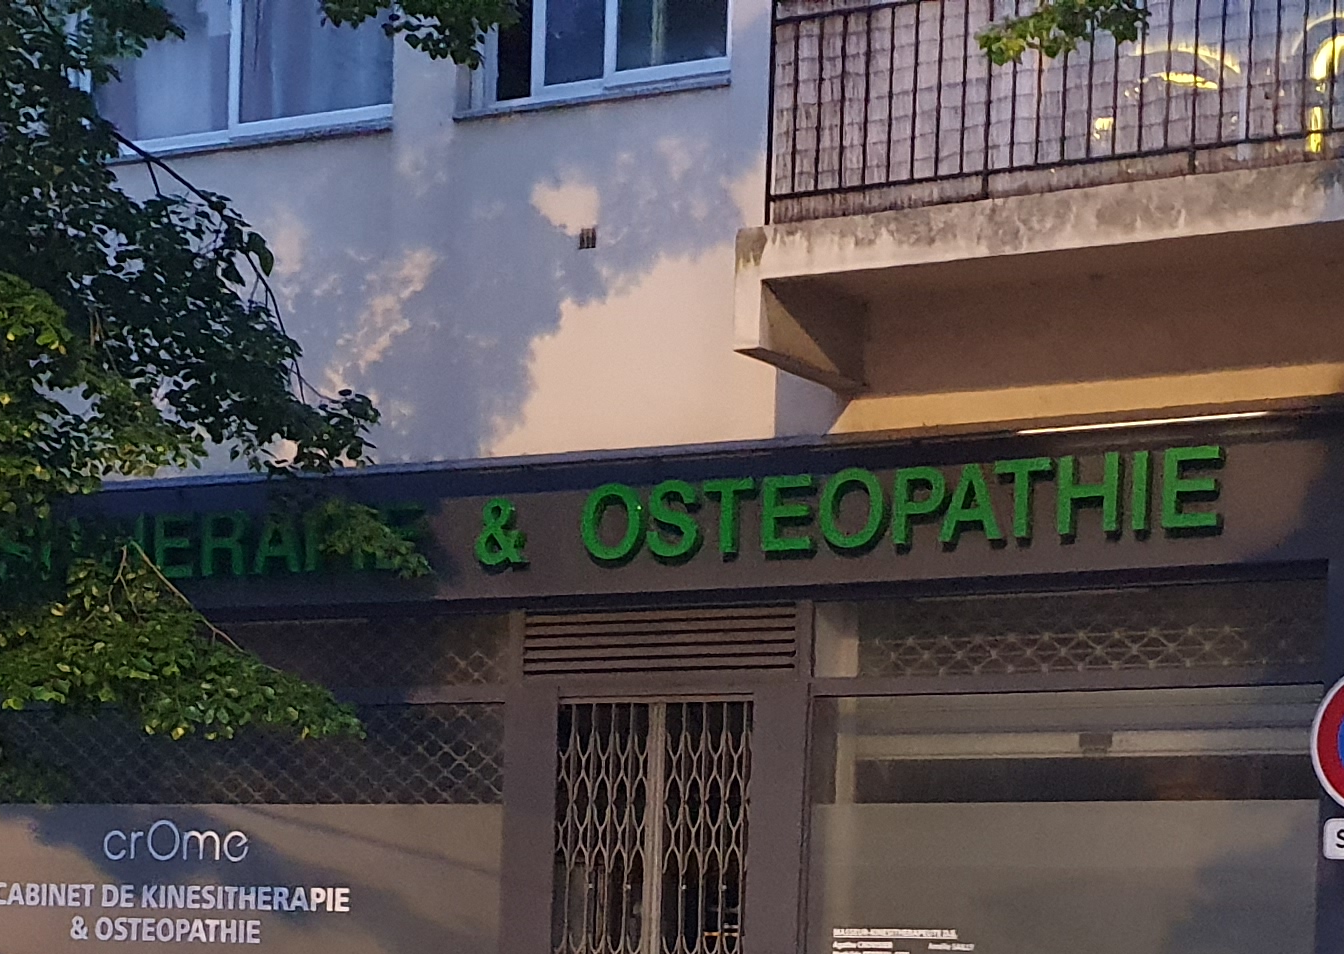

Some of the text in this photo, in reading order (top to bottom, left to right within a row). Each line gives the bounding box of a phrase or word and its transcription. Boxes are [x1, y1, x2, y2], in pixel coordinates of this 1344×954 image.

[475, 498, 527, 568] &
[580, 444, 1225, 563] OSTEOPATHIE
[101, 883, 134, 909] DE
[141, 884, 350, 913] KINESITHERAPIE
[70, 915, 262, 945] & OSTEOPATHIE
